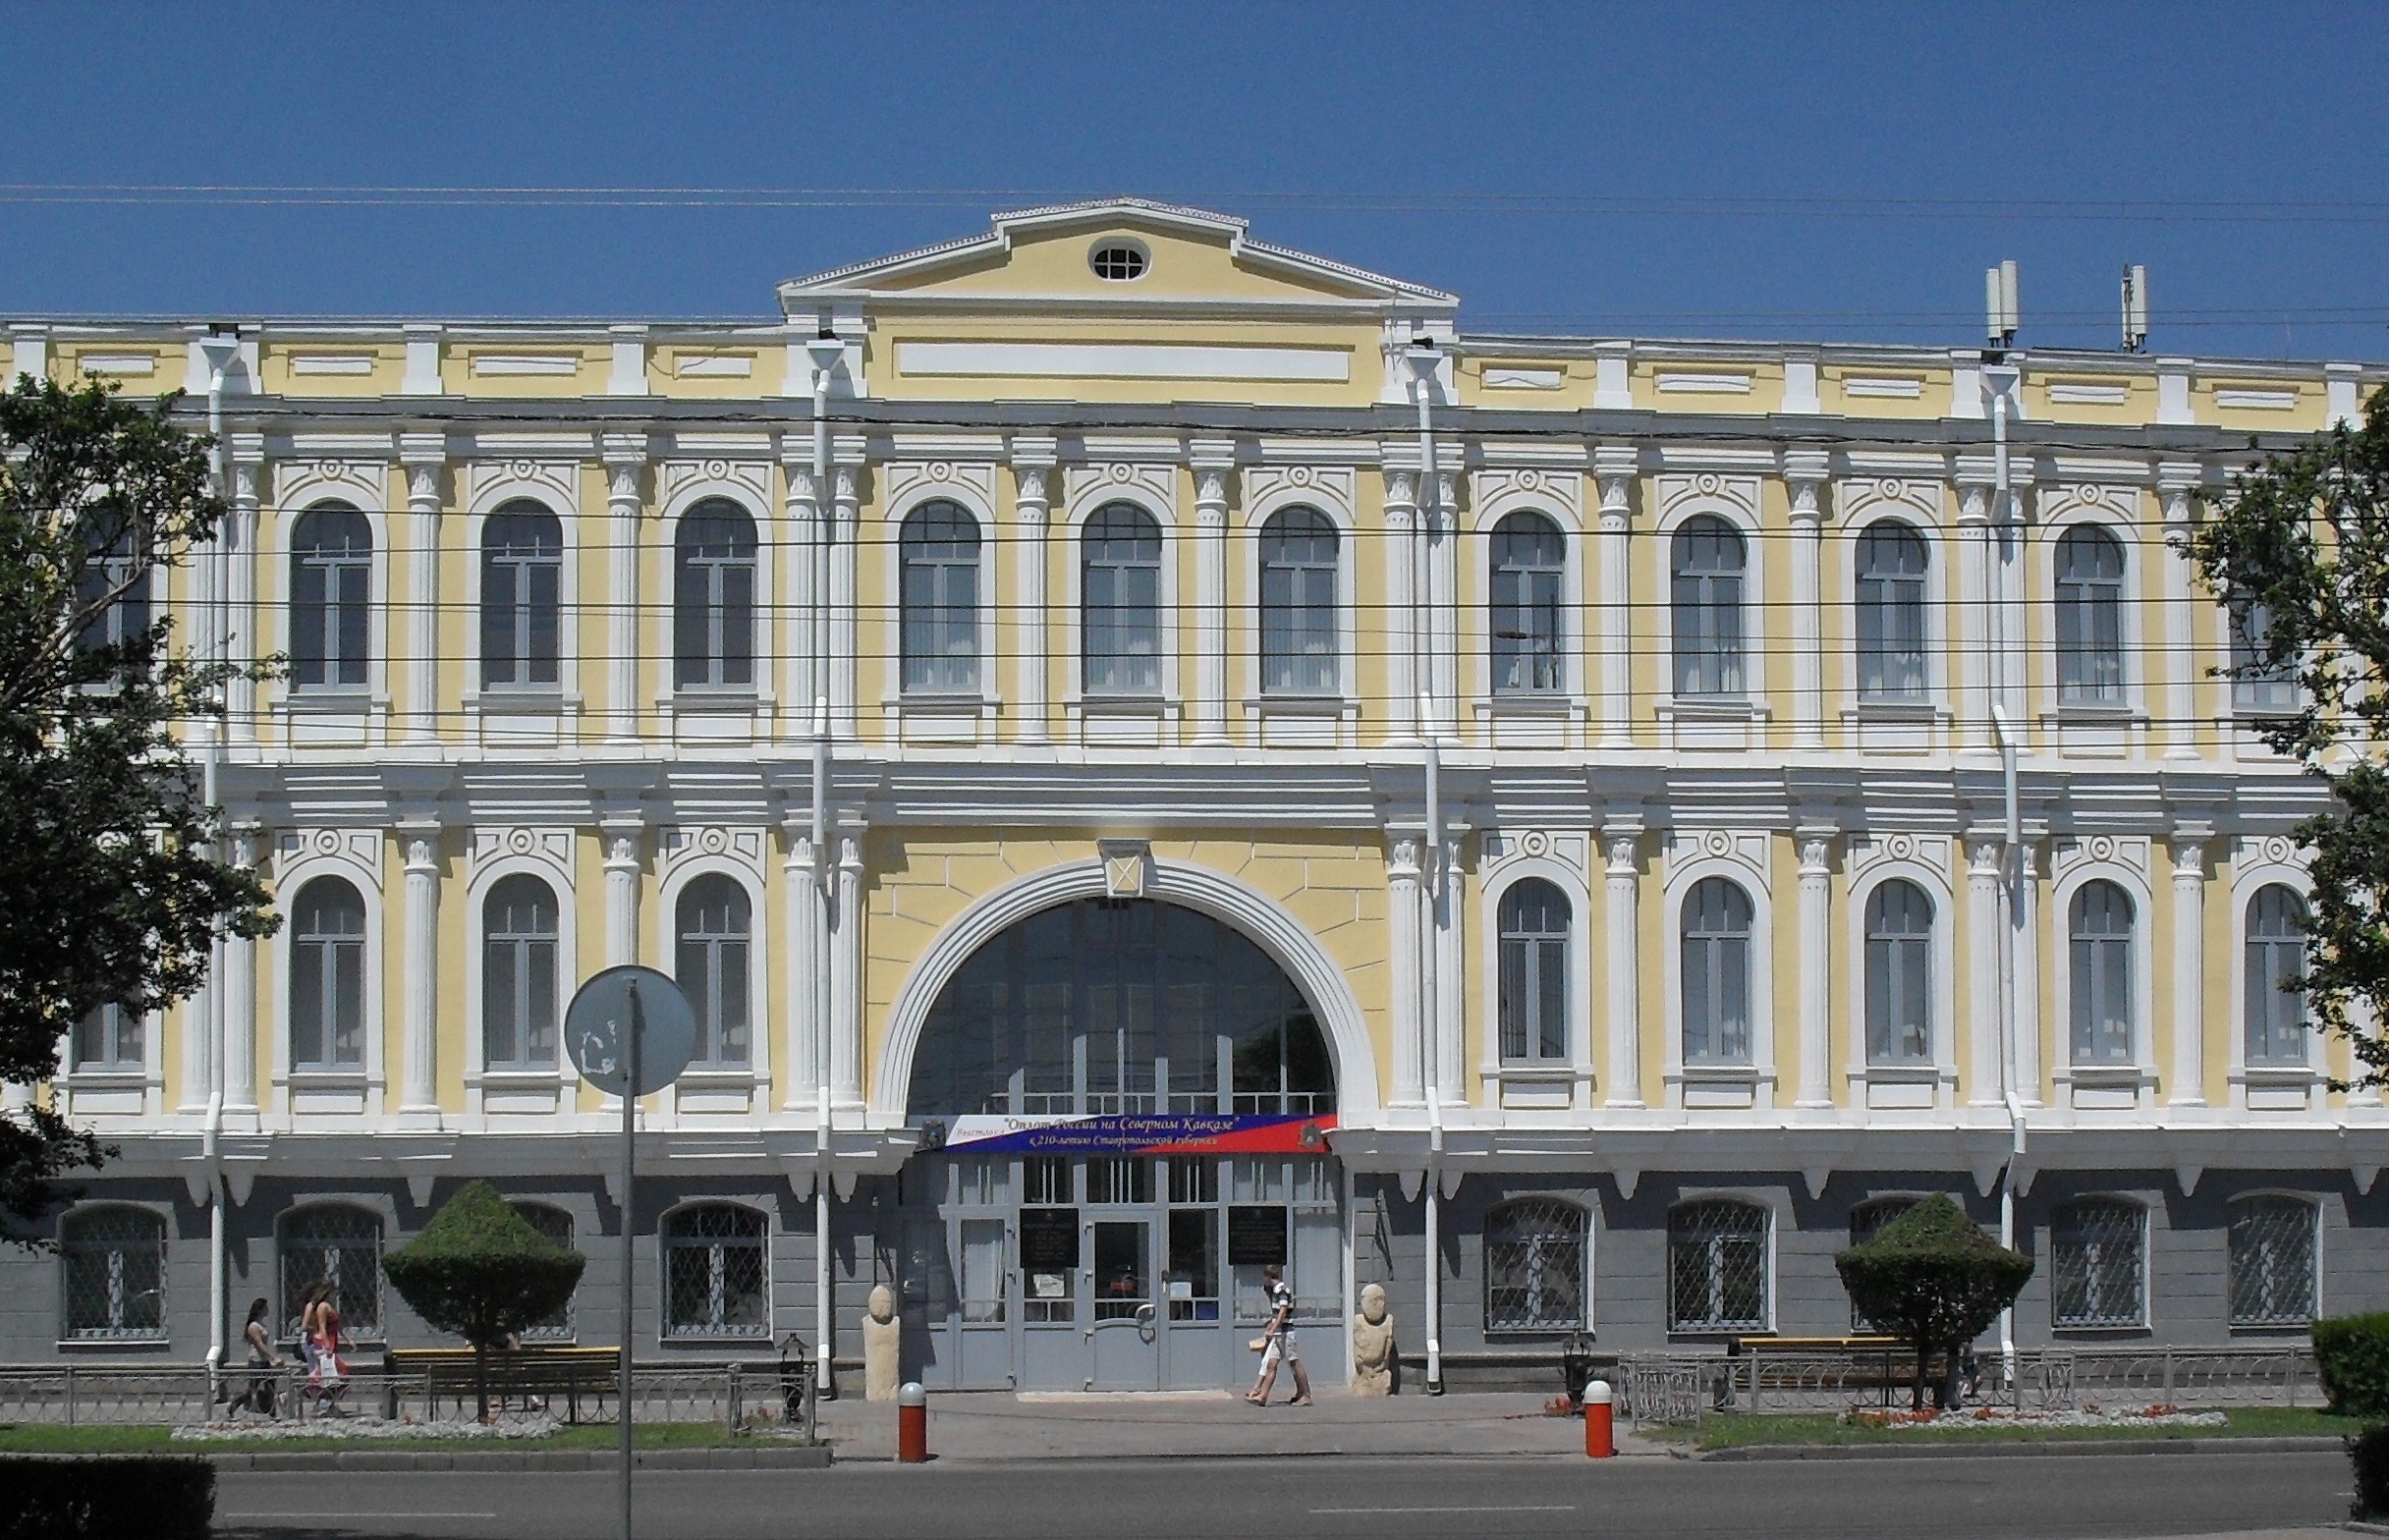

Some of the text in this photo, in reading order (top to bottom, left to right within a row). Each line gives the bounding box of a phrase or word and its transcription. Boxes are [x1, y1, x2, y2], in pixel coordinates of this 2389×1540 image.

[1054, 1118, 1097, 1130] России
[1100, 1120, 1116, 1130] на
[1120, 1118, 1179, 1133] Северном
[1038, 1135, 1091, 1145] 210-летию
[1092, 1135, 1173, 1148] Ставропольской
